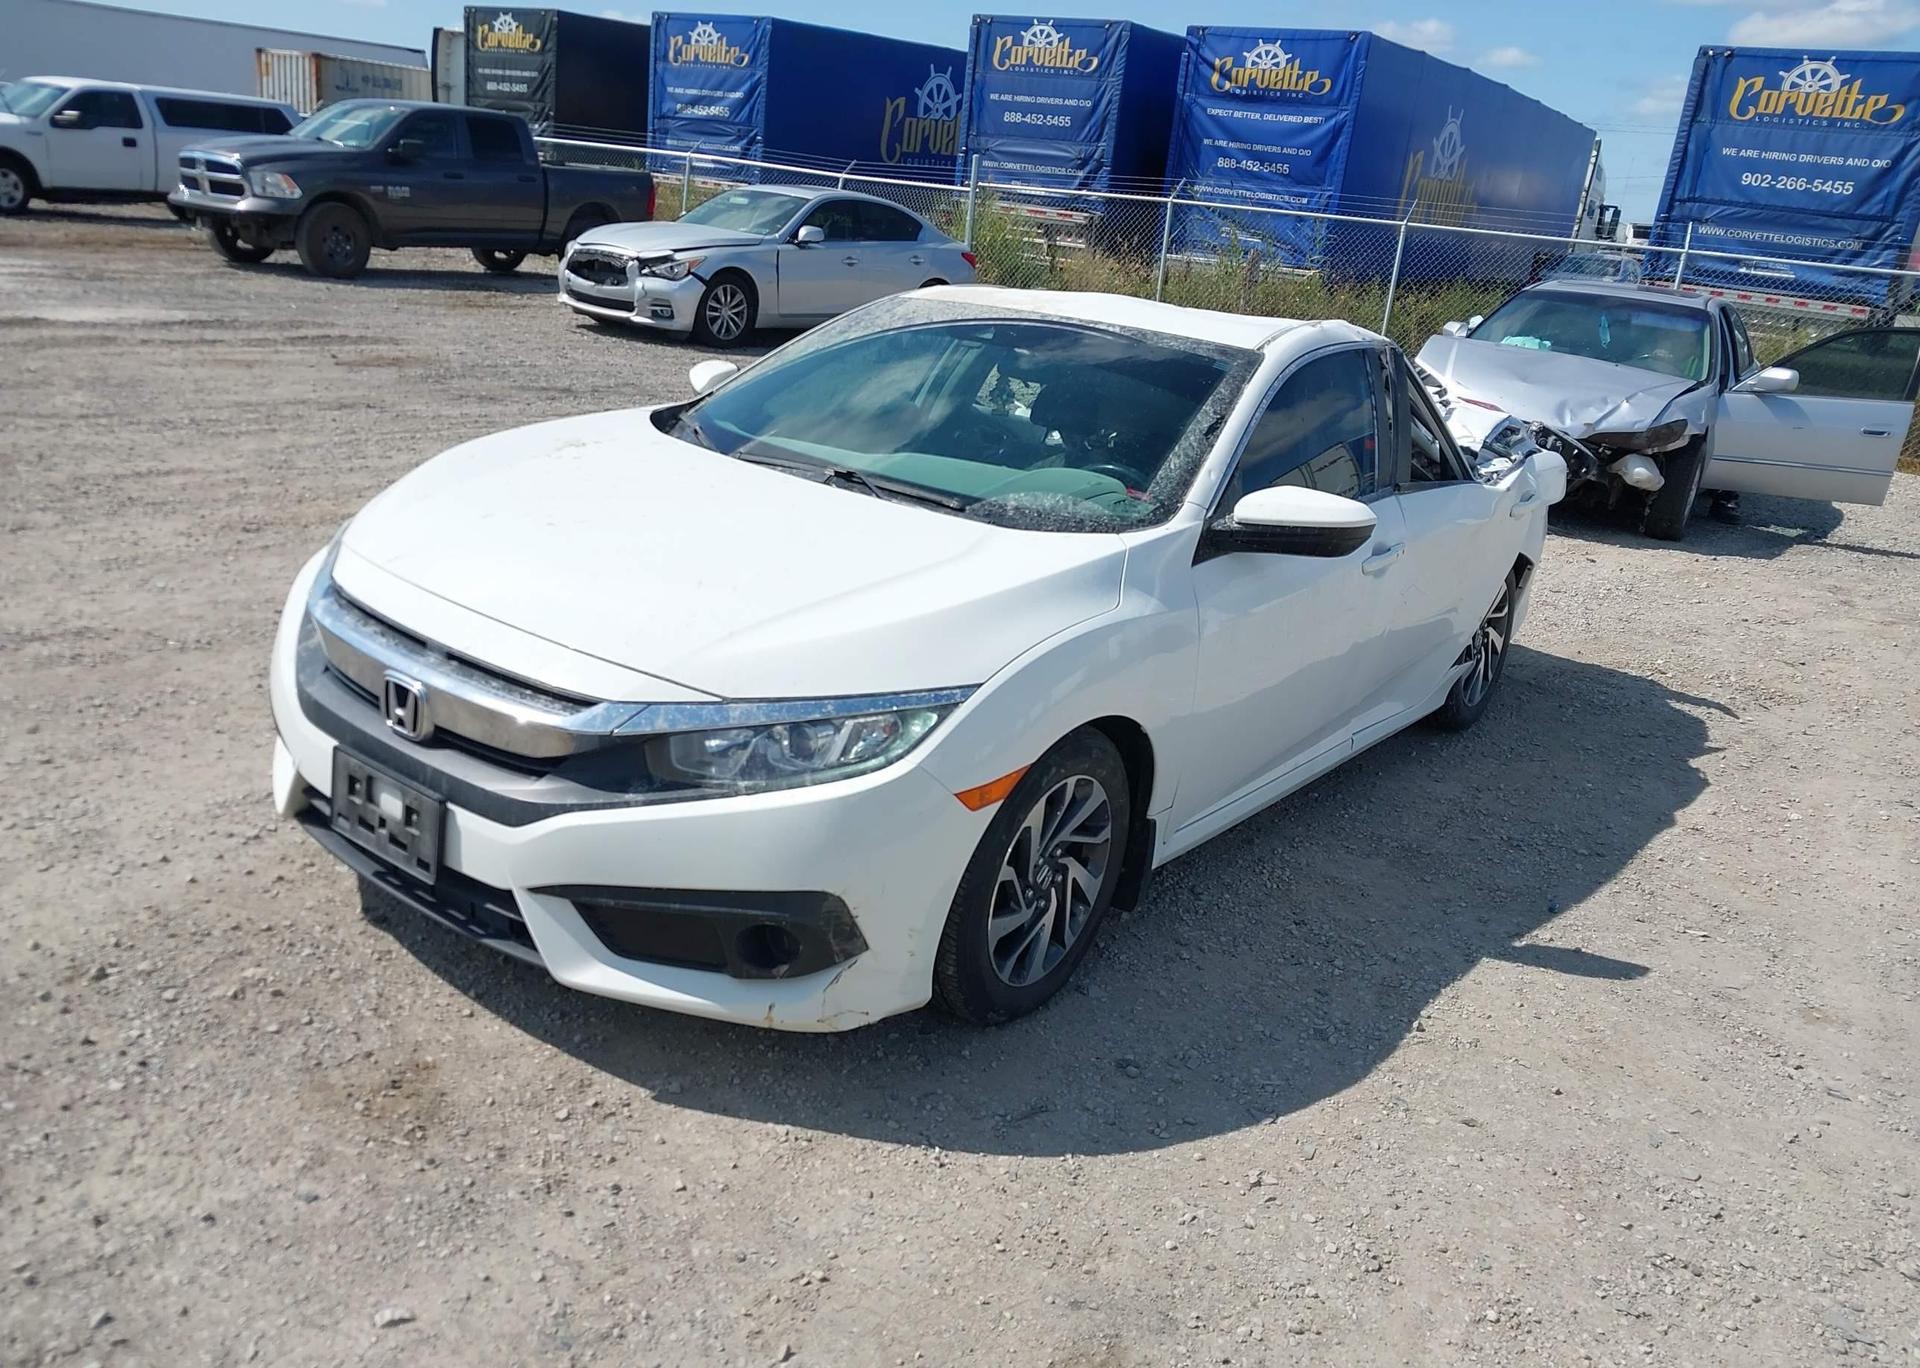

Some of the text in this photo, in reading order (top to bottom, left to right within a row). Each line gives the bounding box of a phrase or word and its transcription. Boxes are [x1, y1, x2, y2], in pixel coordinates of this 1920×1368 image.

[668, 35, 749, 68] Corvette
[993, 36, 1099, 73] Corvette
[1211, 57, 1332, 96] Corvette
[1014, 95, 1035, 103] HIRING
[1036, 96, 1063, 105] DRIVERS
[1729, 76, 1905, 125] Corvette
[1003, 111, 1072, 127] 888-452-5455
[1207, 107, 1233, 117] EXPECT
[1263, 113, 1303, 123] DELIVERED
[1755, 116, 1828, 127] LOGISTICS
[1203, 138, 1213, 146] WE
[1214, 139, 1227, 147] ARE
[1228, 142, 1252, 150] HIRING
[1252, 144, 1282, 153] DRIVERS
[1282, 147, 1298, 155] AND
[1217, 157, 1290, 175] 888-452-5455
[1722, 147, 1892, 169] WE ARE HIRING DRIVERS AND O/O
[1741, 172, 1855, 196] 902-266-5455
[1698, 225, 1864, 251] WWW.CORVETTELOGISTICS.COM
